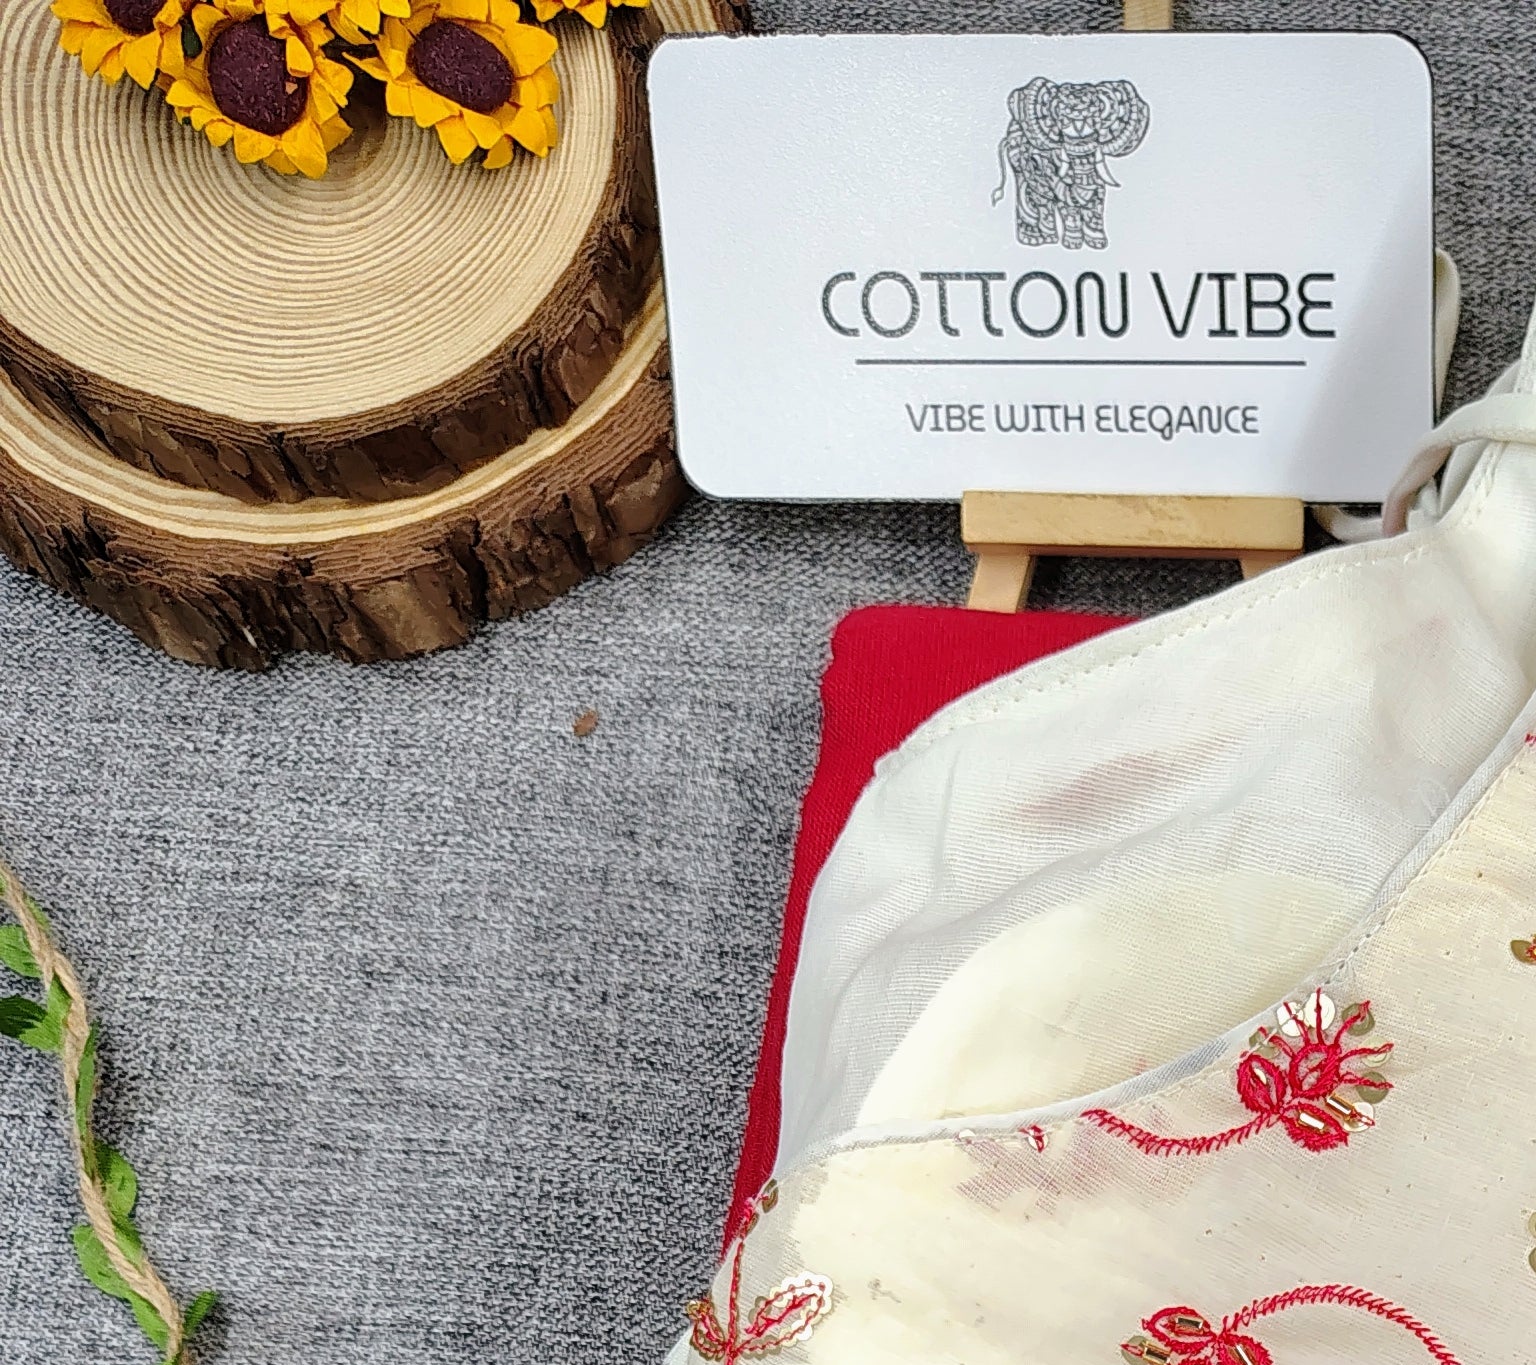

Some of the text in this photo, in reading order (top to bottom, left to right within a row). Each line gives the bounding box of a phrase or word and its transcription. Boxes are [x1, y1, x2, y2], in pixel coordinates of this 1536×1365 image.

[821, 271, 1336, 338] COTTON VIBE
[905, 403, 1259, 441] VIBE WITH ELEGANCE
